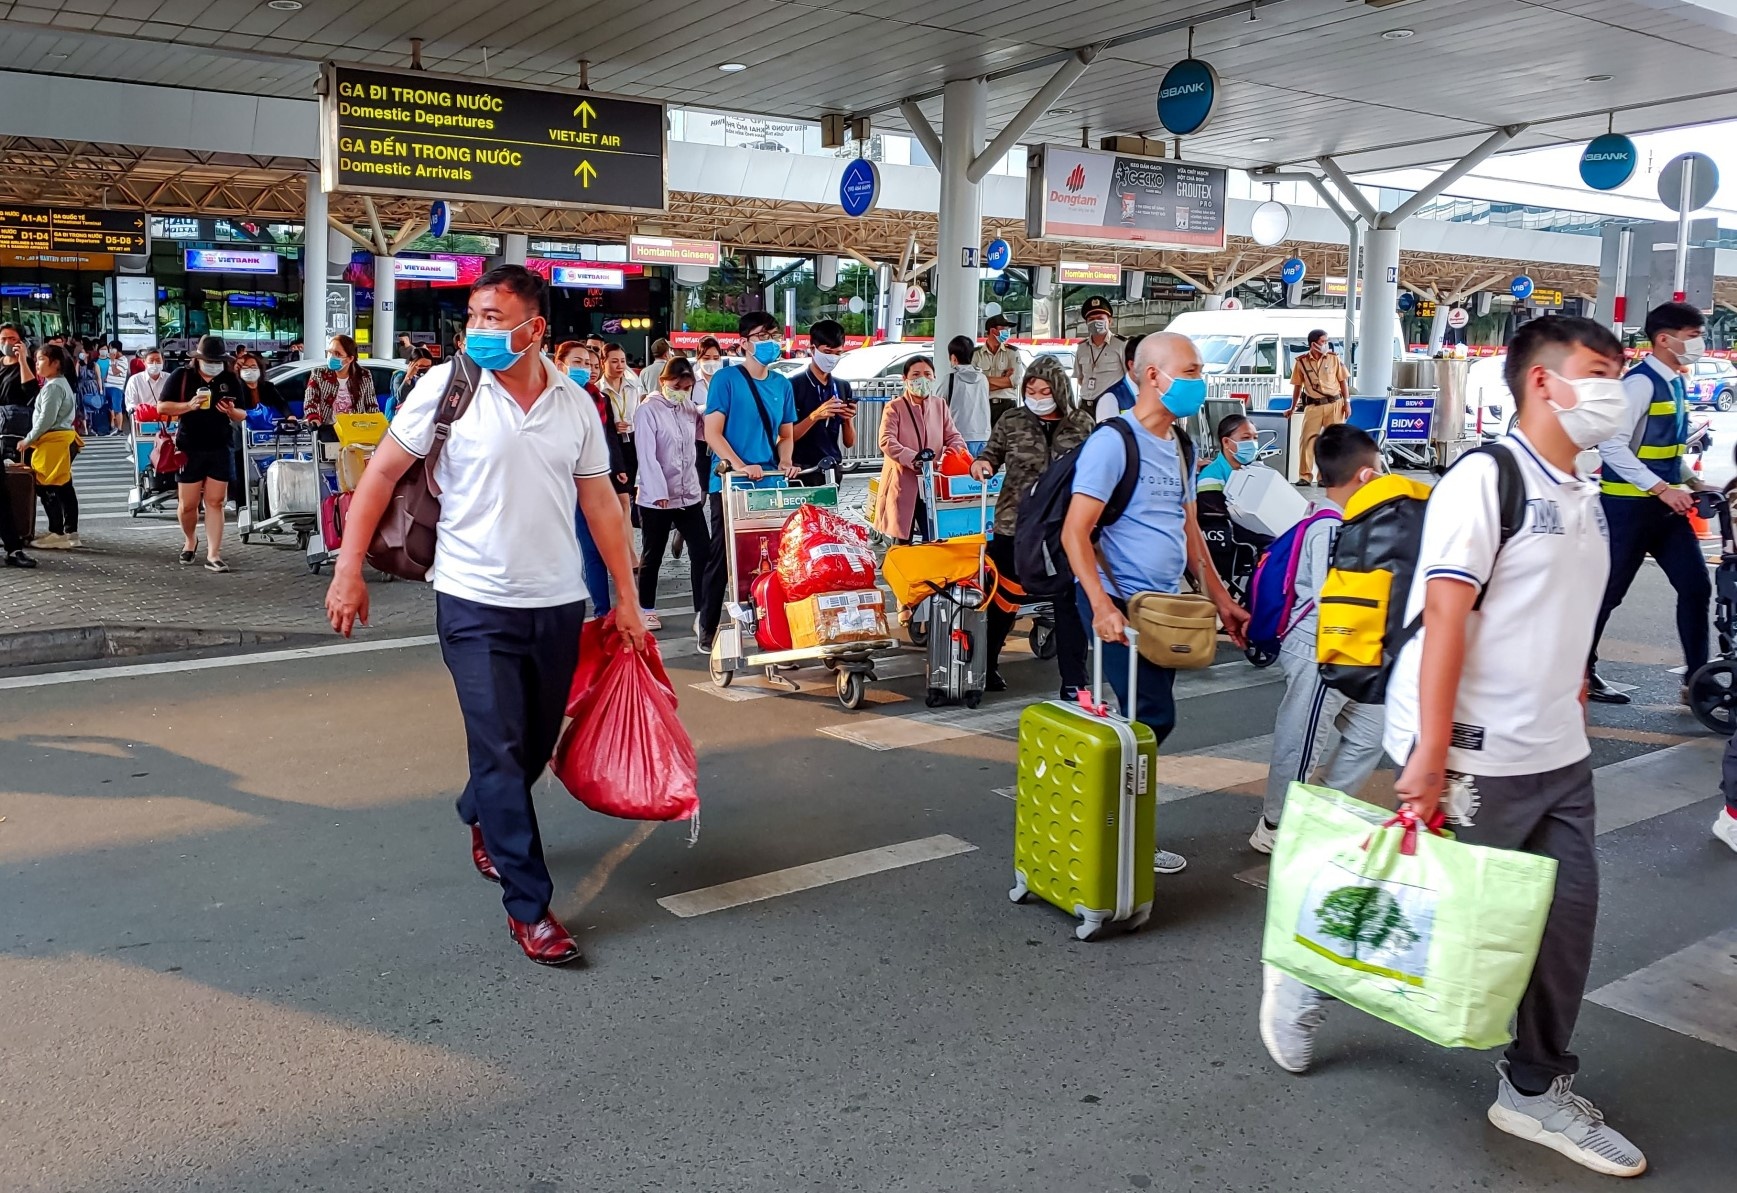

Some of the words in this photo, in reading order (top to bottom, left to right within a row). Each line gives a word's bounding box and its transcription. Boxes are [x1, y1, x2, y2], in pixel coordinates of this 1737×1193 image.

[339, 82, 364, 99] GA
[369, 85, 387, 100] ĐI
[391, 87, 452, 107] TRONG
[456, 93, 503, 112] NƯỚC
[339, 102, 411, 122] Domestic
[415, 110, 494, 129] Departures
[548, 129, 598, 144] VIETJET
[600, 135, 620, 147] AIR
[339, 137, 365, 153] GA
[370, 136, 407, 157] ĐẾN
[412, 143, 471, 162] TRONG
[476, 148, 522, 166] NƯỚC
[340, 157, 412, 175] Domestic
[415, 164, 472, 180] Arrivals
[1128, 170, 1165, 188] GECKO
[1176, 182, 1212, 199] GROUTEX
[1050, 190, 1097, 207] Dongtam
[1199, 200, 1213, 208] PRO
[21, 214, 48, 223] A1-A3
[21, 231, 49, 240] D1-D4
[105, 236, 132, 245] D5-D8
[636, 246, 680, 258] Homtamin
[680, 249, 715, 261] Ginseng
[988, 251, 1000, 261] VIB
[217, 256, 260, 264] VIETBANK
[403, 264, 442, 272] VIETBANK
[1283, 268, 1295, 276] VIB
[577, 273, 610, 281] VIETBANK
[1064, 269, 1094, 279] Homtamin
[1094, 271, 1117, 282] Ginseng
[1511, 284, 1525, 292] VIB
[1391, 419, 1415, 428] BIDV
[769, 496, 807, 506] HBECO
[1201, 530, 1225, 541] AGS
